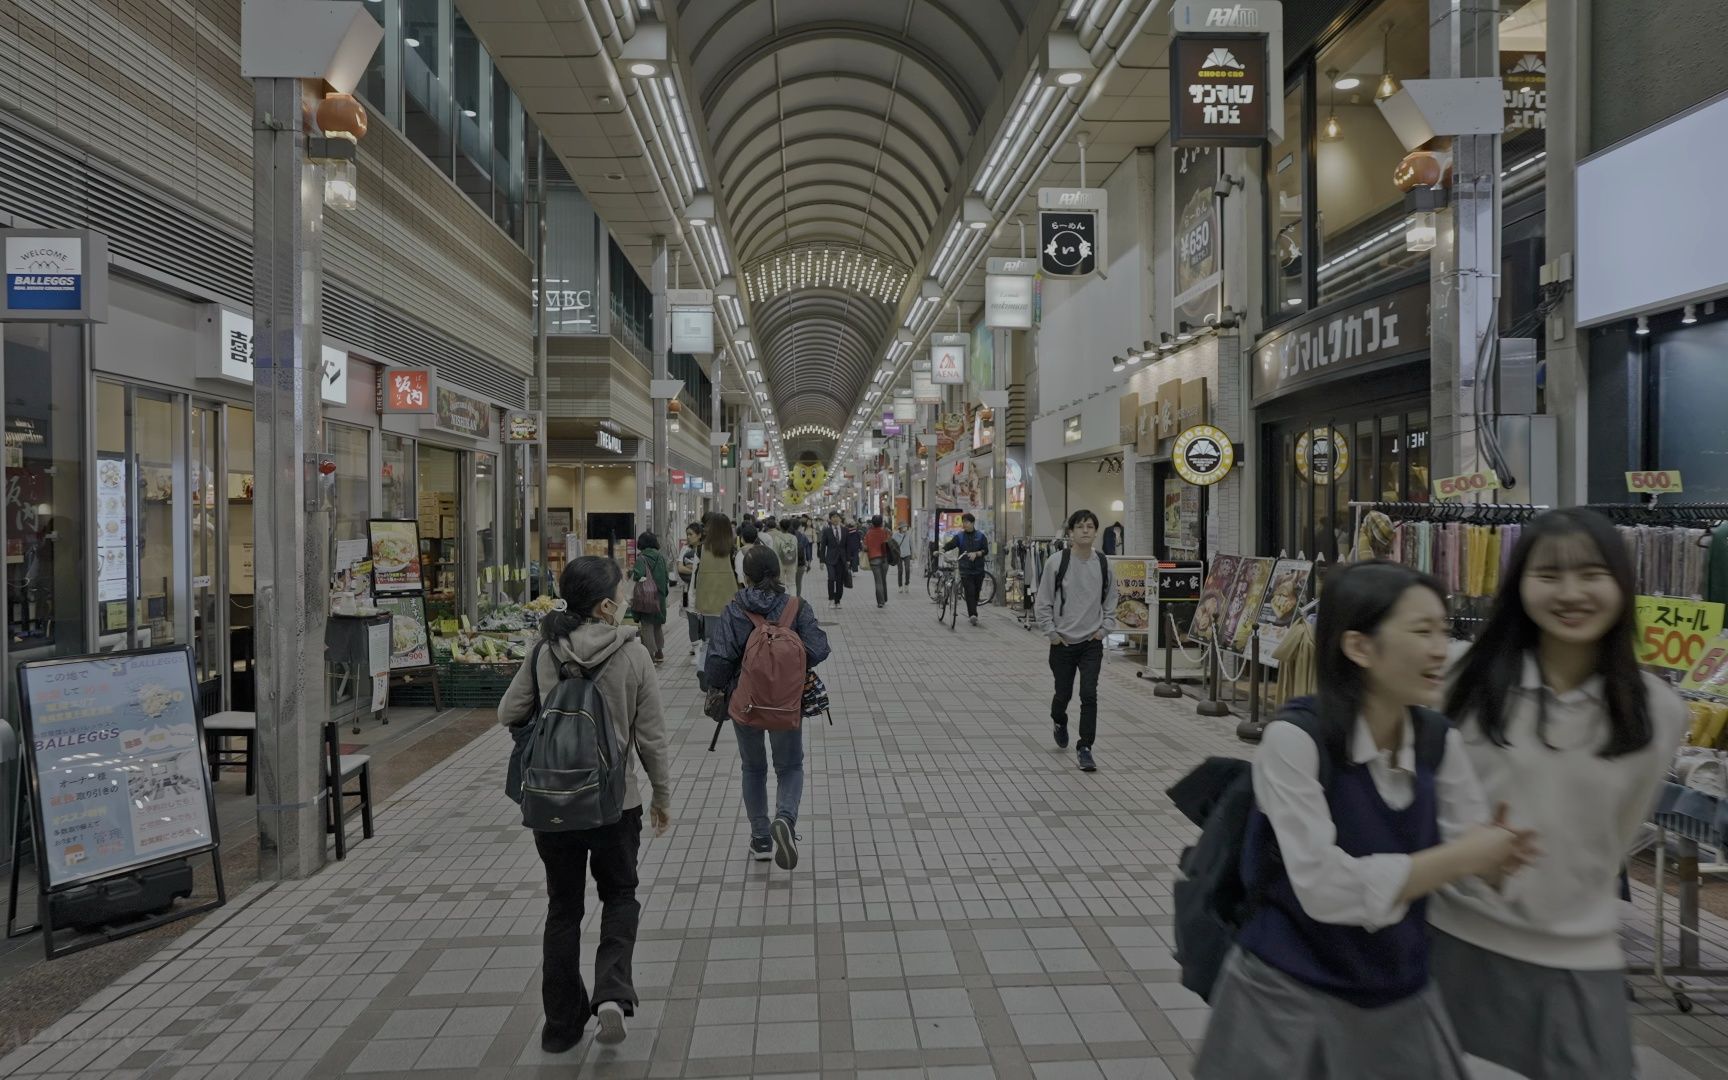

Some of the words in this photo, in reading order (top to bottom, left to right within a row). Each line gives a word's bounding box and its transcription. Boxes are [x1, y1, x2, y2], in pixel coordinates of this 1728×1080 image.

[1188, 85, 1254, 104] サンマルク
[1203, 105, 1240, 124] カフェ
[1051, 222, 1086, 230] らーめん
[20, 248, 69, 262] WELCOME
[14, 276, 75, 286] BALLEGGS
[1440, 474, 1488, 494] 500
[1631, 472, 1672, 489] 500
[1654, 606, 1710, 632] ストール
[1641, 626, 1705, 667] 500
[33, 727, 120, 752] BALLEGGS
